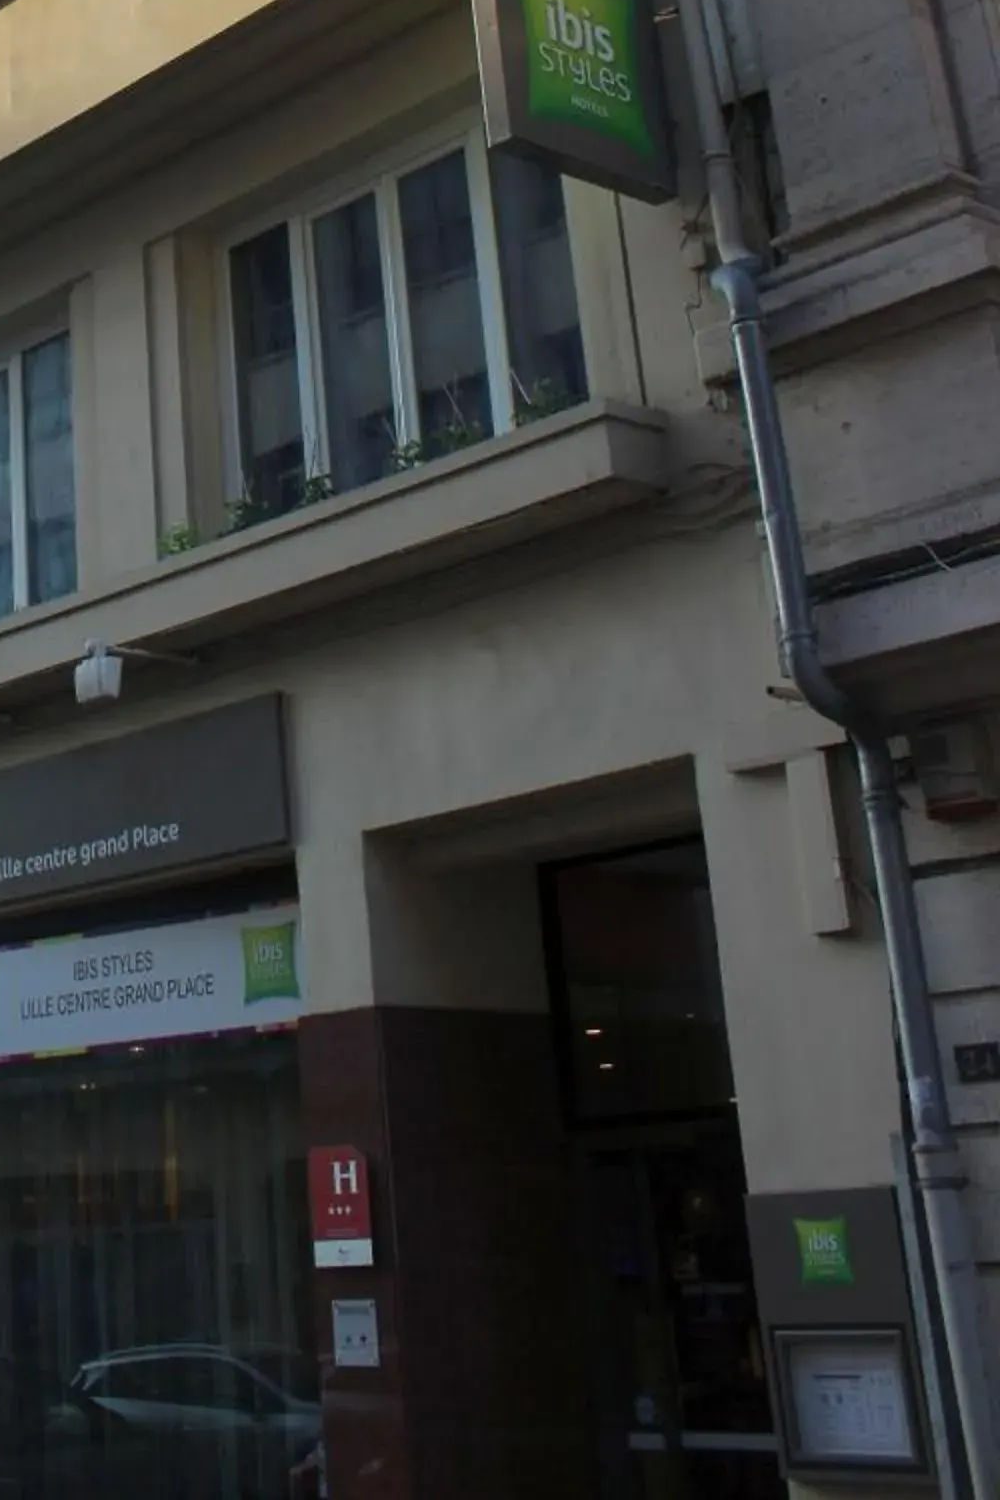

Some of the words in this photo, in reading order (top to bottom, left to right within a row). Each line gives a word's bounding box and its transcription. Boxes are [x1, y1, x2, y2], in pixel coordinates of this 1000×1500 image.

[24, 846, 77, 874] centre
[80, 832, 129, 867] grand
[132, 820, 180, 848] Place
[72, 956, 99, 982] IBIS
[100, 949, 154, 976] STYLES
[20, 992, 56, 1020] LILLE
[57, 986, 112, 1016] CENTRE
[113, 979, 165, 1007] GRAND
[166, 973, 215, 1000] PLACE
[330, 1159, 360, 1195] H
